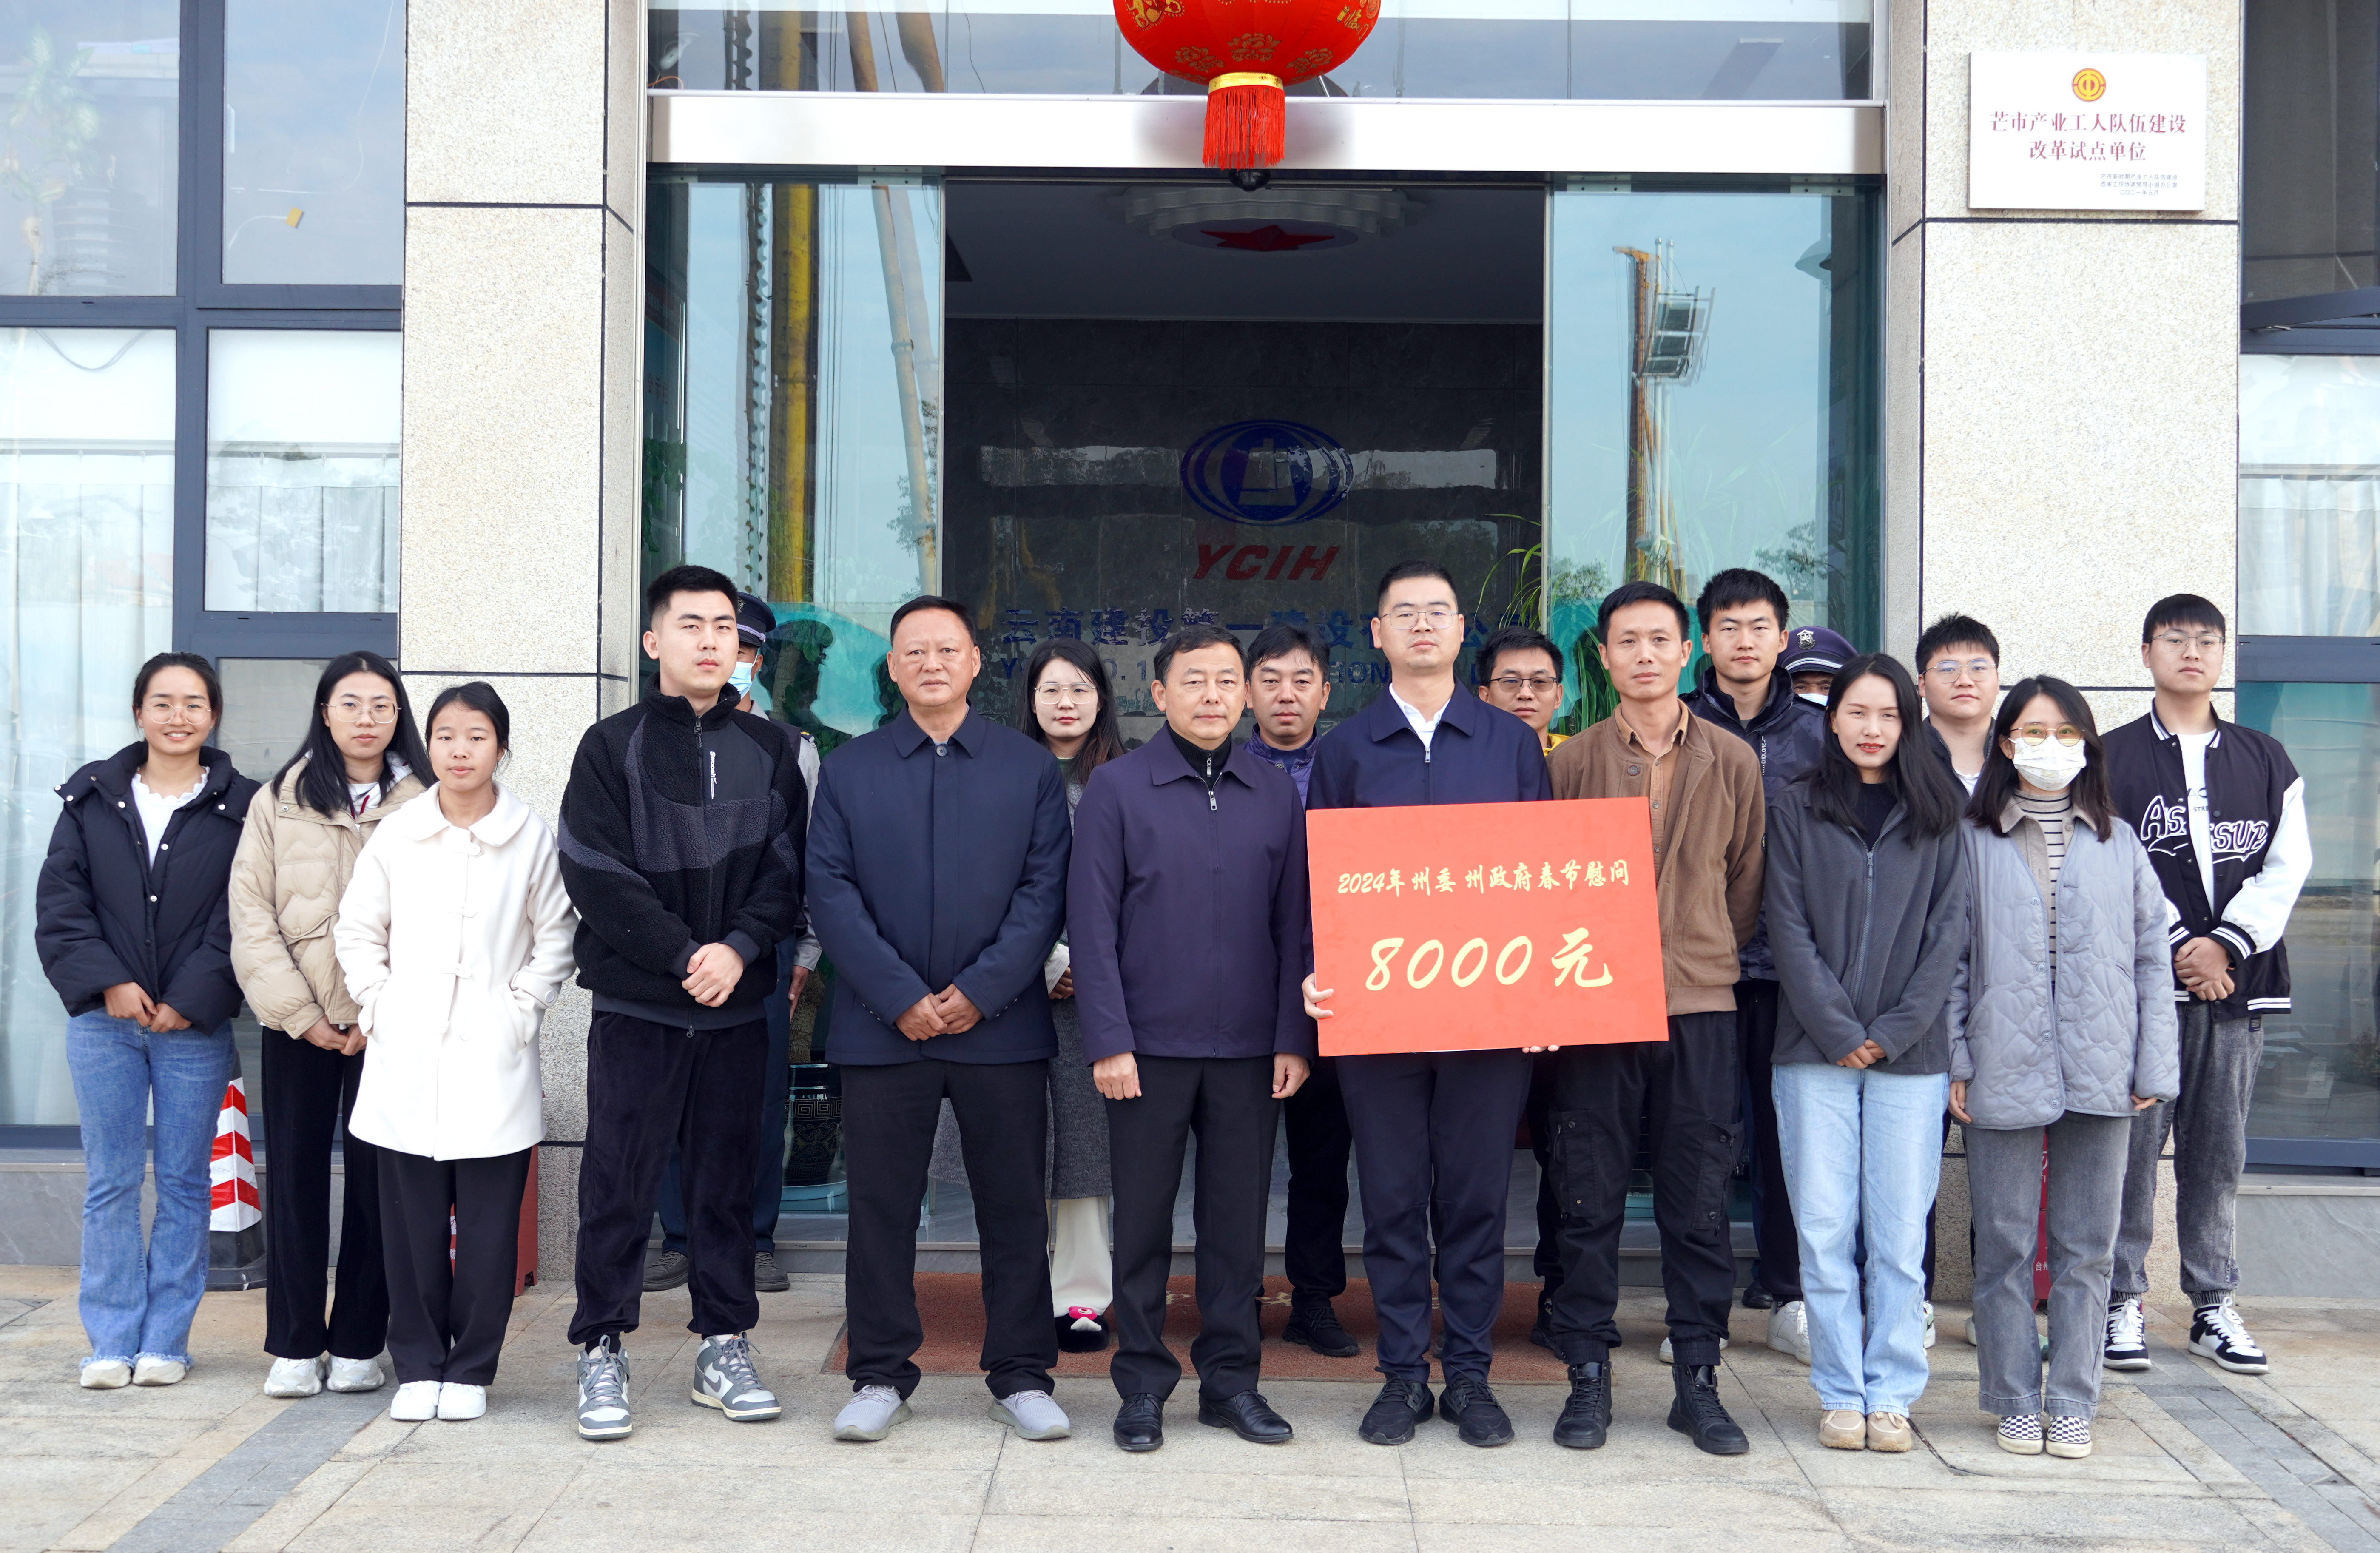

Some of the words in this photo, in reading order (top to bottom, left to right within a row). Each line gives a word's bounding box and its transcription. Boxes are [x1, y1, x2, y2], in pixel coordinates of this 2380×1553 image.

[1990, 111, 2186, 134] 芒市产业工人队伍建设
[2030, 140, 2146, 161] 改革试点单位
[1193, 544, 1340, 580] YCIH
